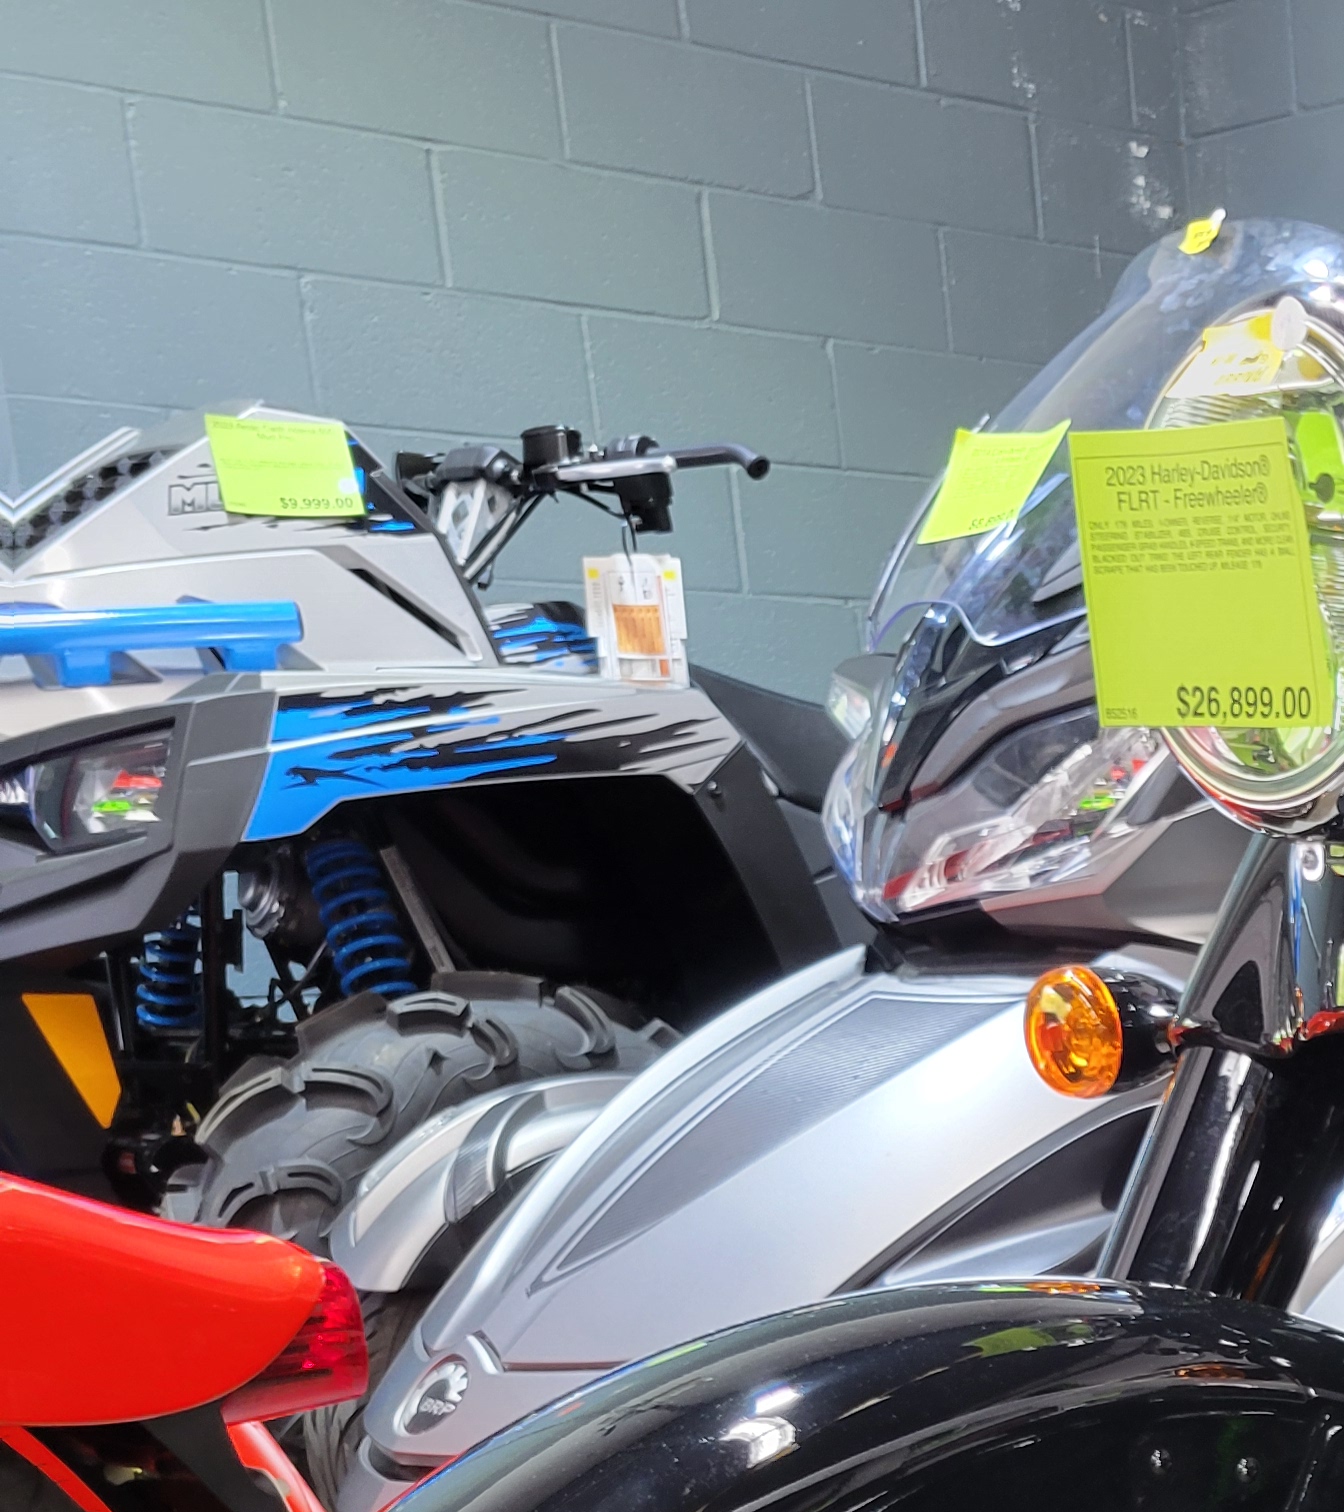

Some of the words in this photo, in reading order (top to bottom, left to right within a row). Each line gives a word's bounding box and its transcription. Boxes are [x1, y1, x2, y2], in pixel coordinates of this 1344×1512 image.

[1105, 465, 1146, 487] 2023
[1150, 454, 1271, 488] Harley-Davidson®
[1116, 490, 1160, 512] FLRT
[1173, 481, 1268, 509] Freewheeler®
[1175, 682, 1311, 723] $26,899.00
[421, 1396, 457, 1416] BRP
